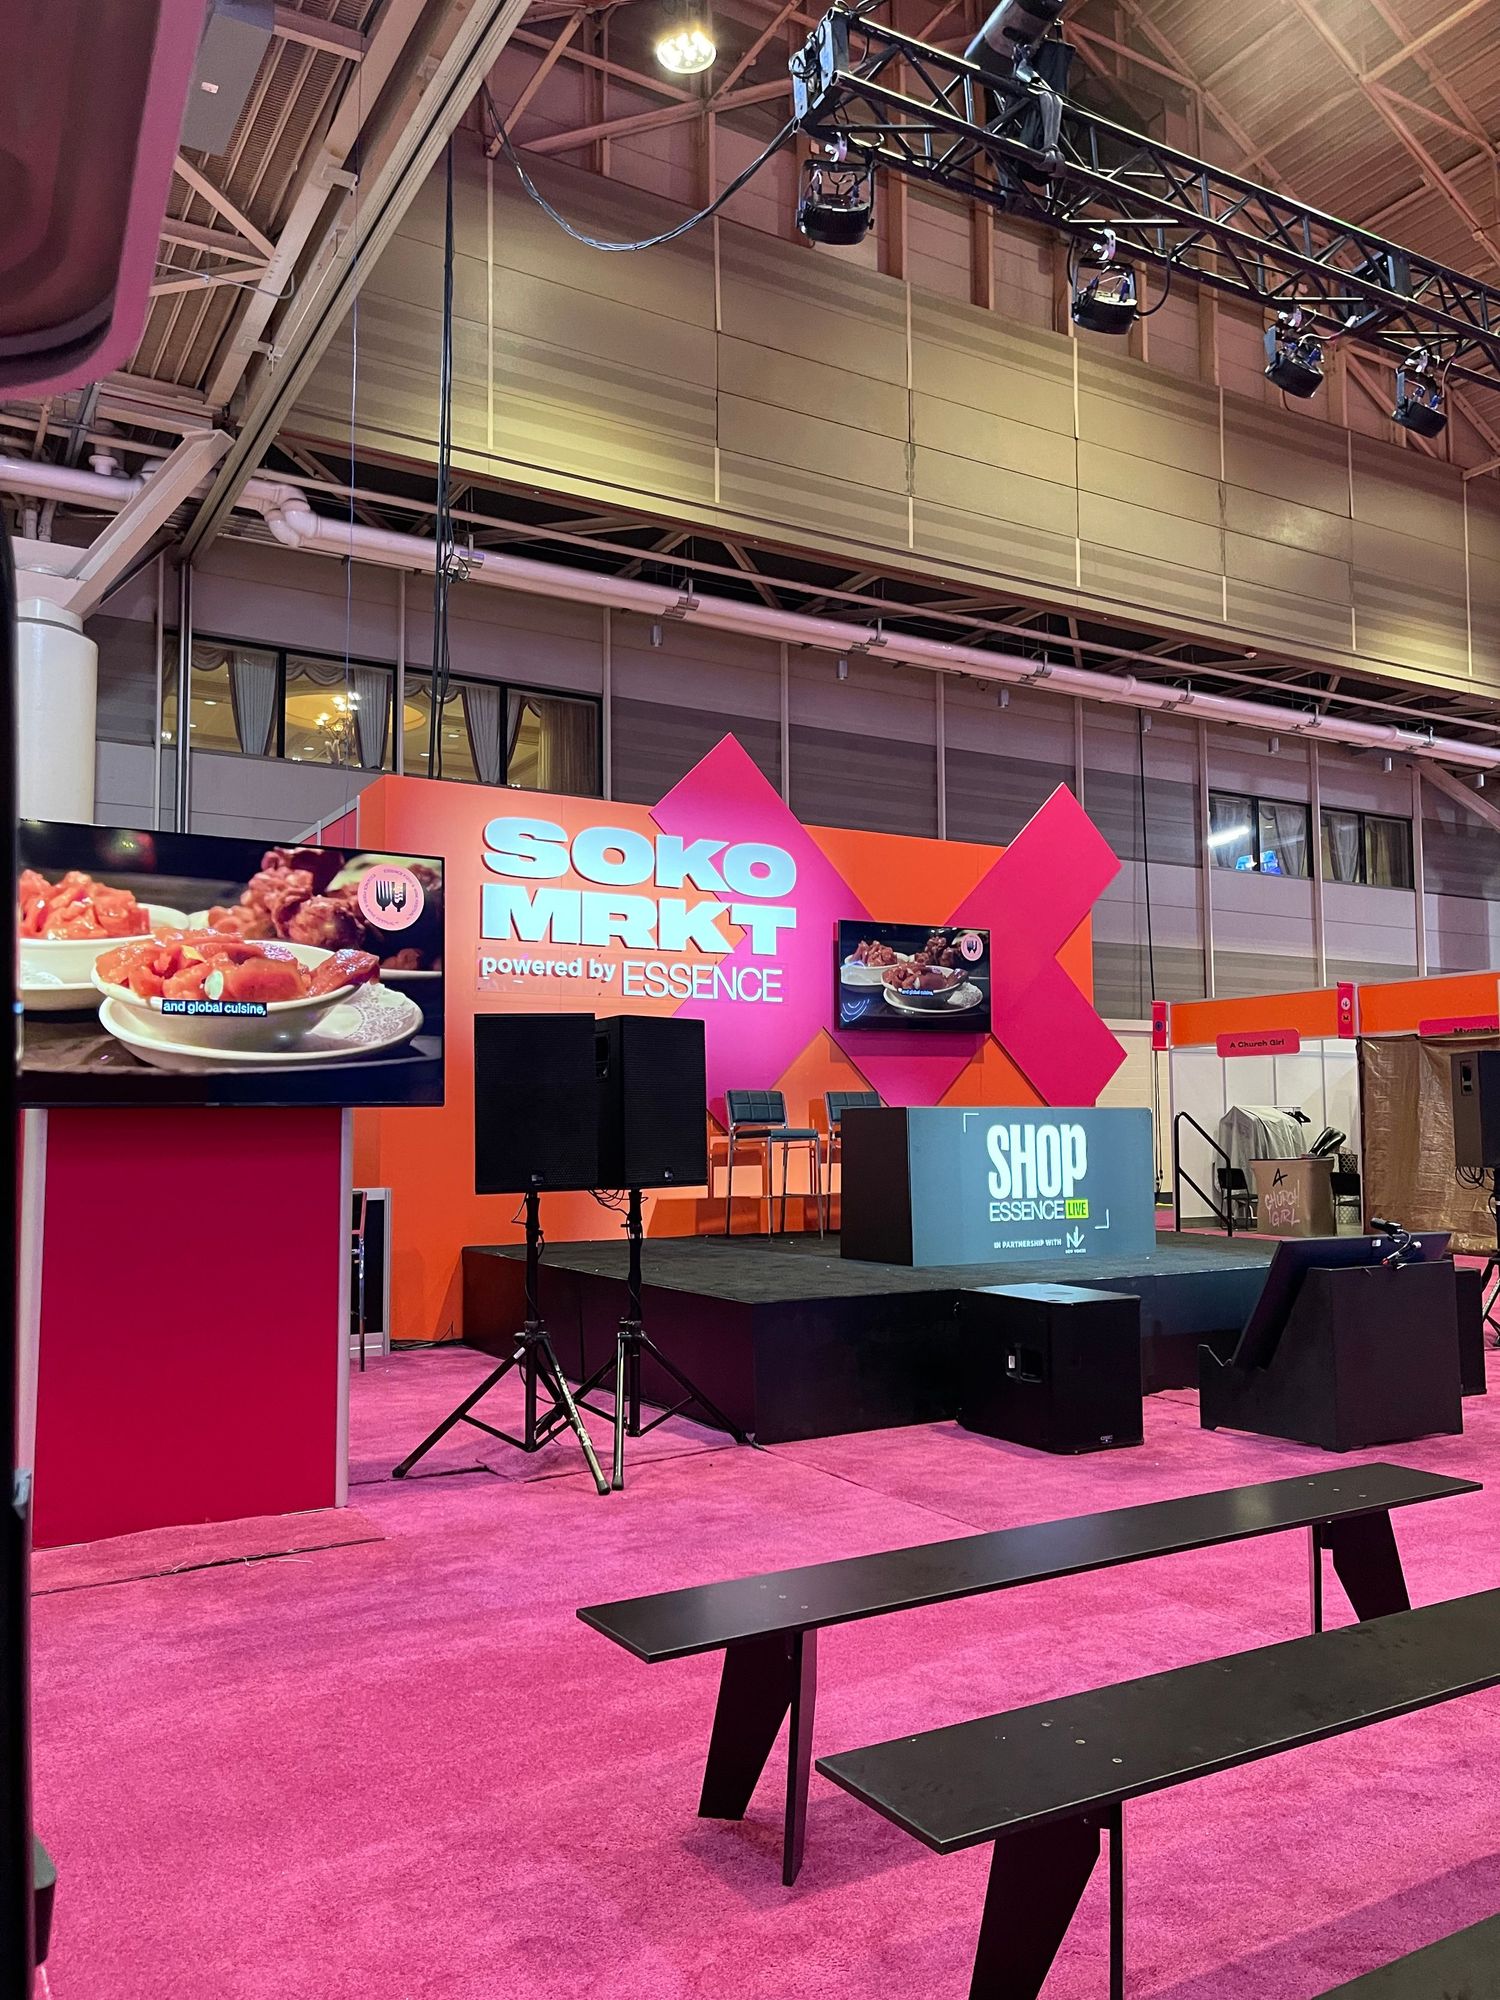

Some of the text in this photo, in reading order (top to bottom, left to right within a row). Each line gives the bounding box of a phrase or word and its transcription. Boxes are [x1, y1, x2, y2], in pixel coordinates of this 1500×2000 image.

[482, 816, 797, 899] SOKO
[481, 882, 797, 956] MRKT
[481, 957, 784, 1003] powered by ESSENCE
[163, 1001, 267, 1016] and global cuisine,
[1237, 1040, 1268, 1048] Church
[1269, 1038, 1285, 1046] Girl
[986, 1124, 1088, 1199] SHOP
[1272, 1168, 1288, 1187] A
[989, 1200, 1087, 1222] ESSENCE LIVE
[1270, 1208, 1300, 1227] GIRL
[1002, 1240, 1044, 1249] PARTNERSHIP
[1045, 1239, 1062, 1247] WITH
